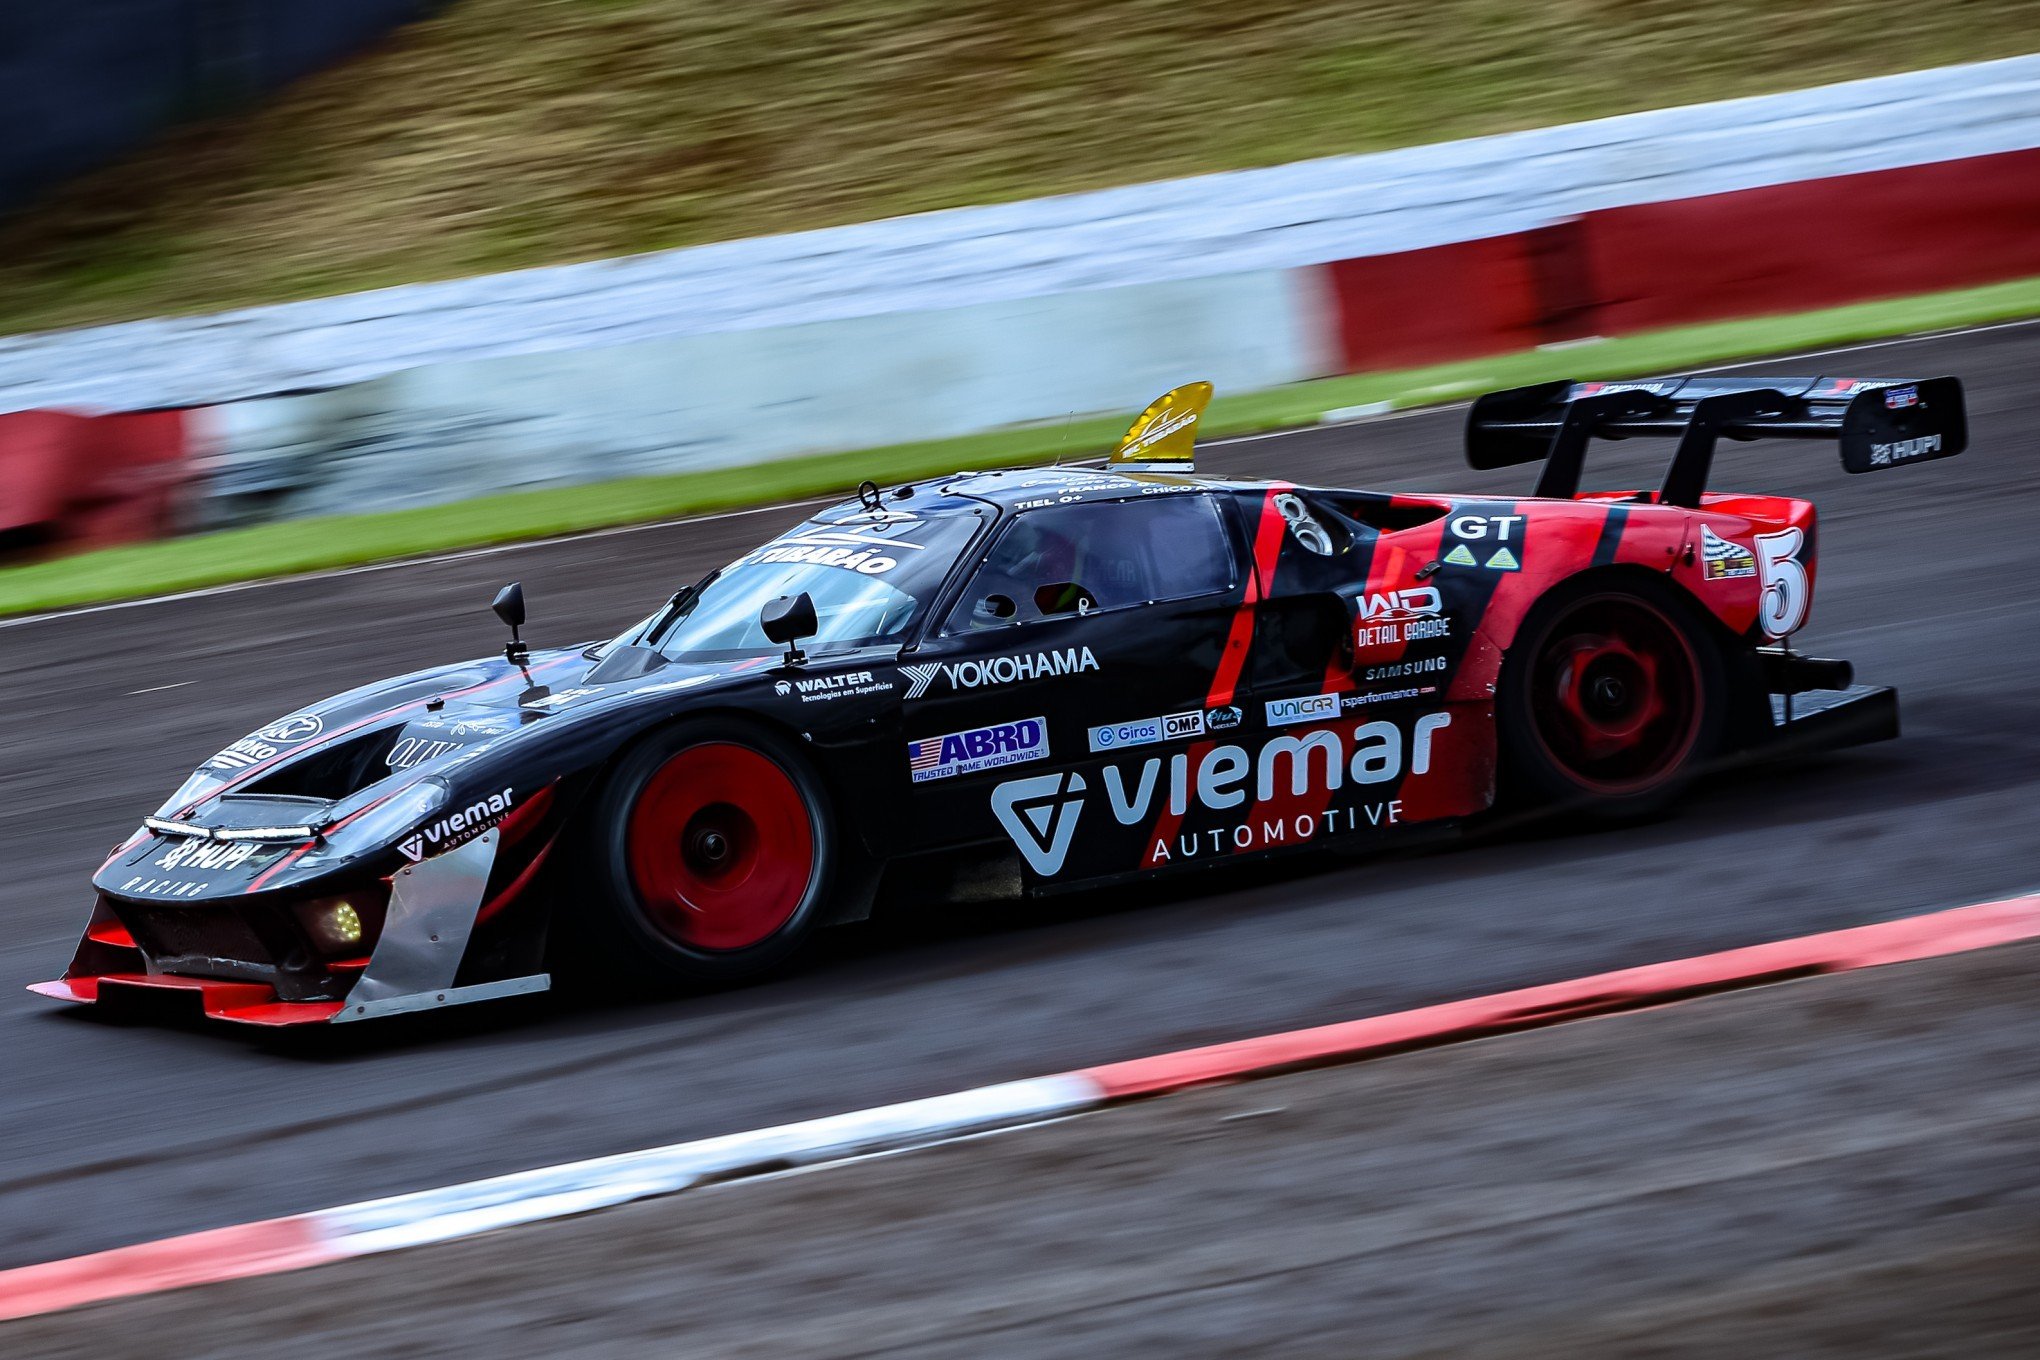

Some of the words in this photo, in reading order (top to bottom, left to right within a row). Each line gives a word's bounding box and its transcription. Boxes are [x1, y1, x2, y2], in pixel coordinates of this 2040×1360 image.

[1892, 433, 1942, 460] HUPI
[1141, 485, 1194, 495] CHICO
[1014, 497, 1056, 511] TIEL
[1450, 515, 1522, 541] GT
[1754, 526, 1809, 640] 5
[1358, 624, 1402, 648] DETAIL
[1404, 617, 1452, 641] GARAGE
[941, 646, 1101, 690] YOKOHAMA
[1365, 656, 1447, 681] SAMSUNG
[795, 671, 874, 693] WALTER
[801, 691, 842, 703] Tecnologias
[843, 688, 855, 696] em
[1271, 696, 1334, 717] UNICAR
[1118, 725, 1156, 741] Giros
[1166, 716, 1201, 734] OMP
[938, 719, 1042, 766] ABRO
[913, 767, 953, 782] TRUSTED
[984, 750, 1040, 767] WORLDWIDE
[443, 812, 510, 849] AUTOMOTIVE
[1151, 799, 1404, 863] AUTOMOTIVE
[119, 876, 209, 897] RACING
